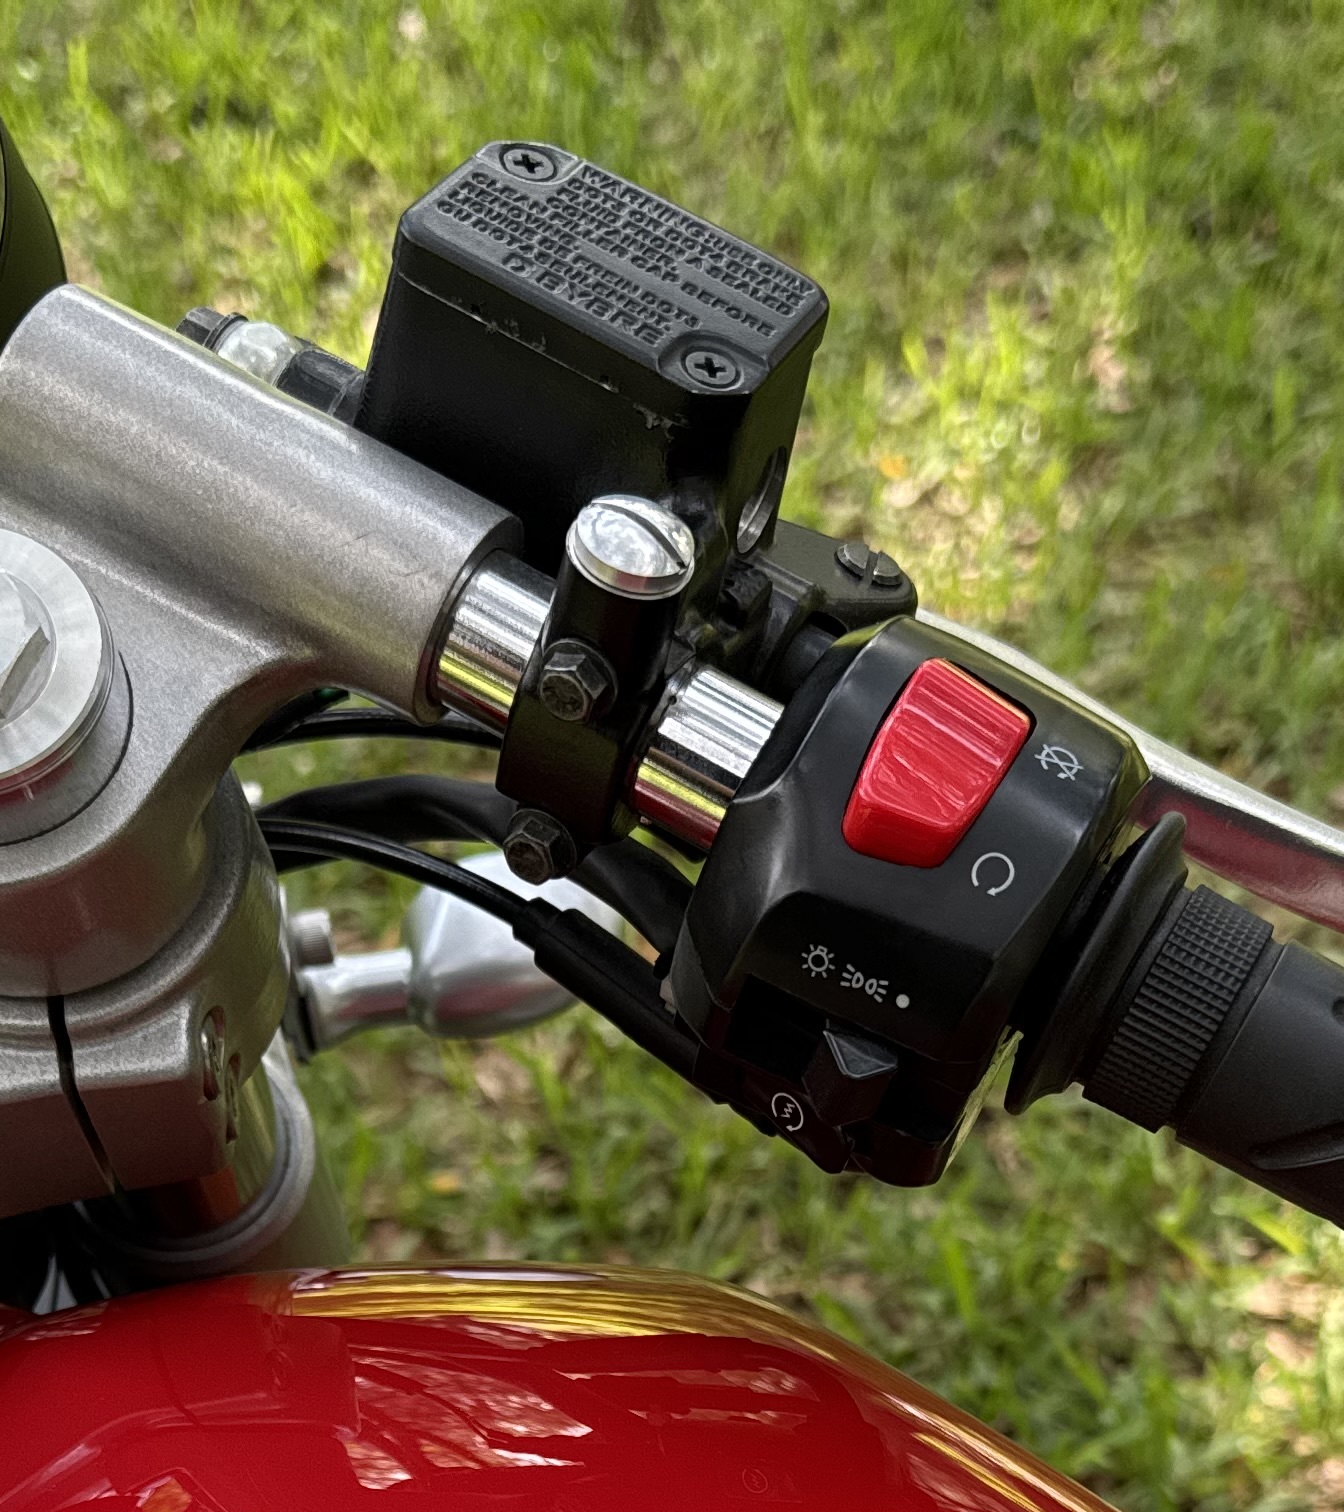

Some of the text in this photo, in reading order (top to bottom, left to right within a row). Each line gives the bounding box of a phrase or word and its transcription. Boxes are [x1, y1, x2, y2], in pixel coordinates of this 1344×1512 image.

[688, 254, 705, 269] A
[536, 270, 665, 346] BYBRE
[682, 281, 775, 337] BEFORE
